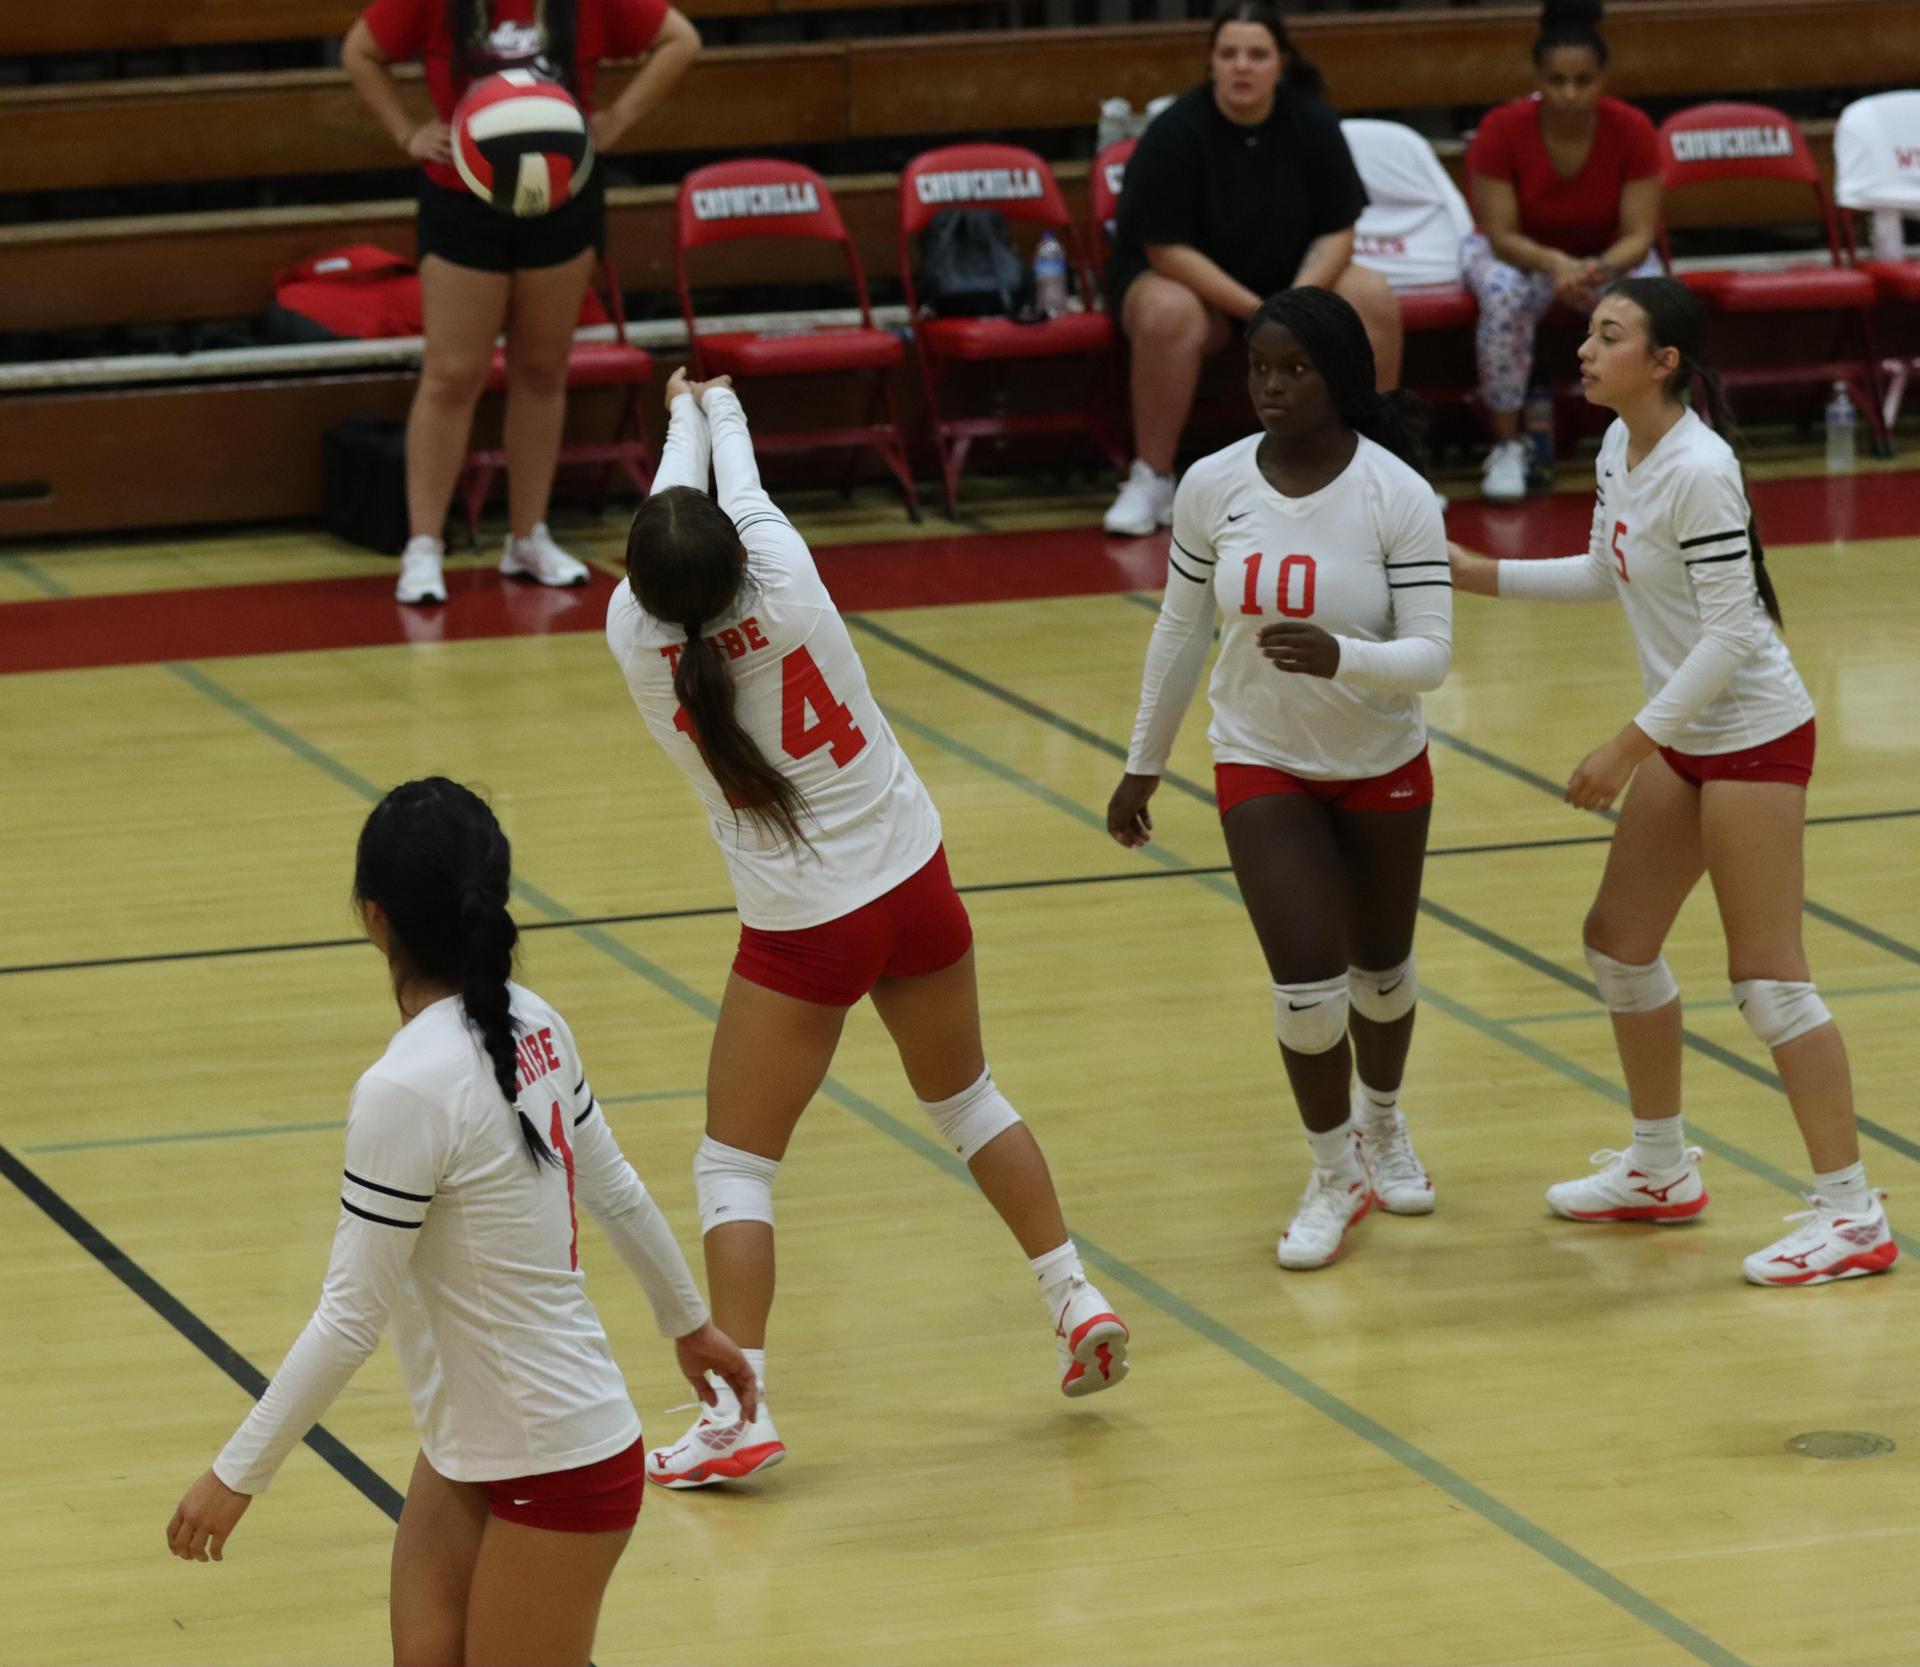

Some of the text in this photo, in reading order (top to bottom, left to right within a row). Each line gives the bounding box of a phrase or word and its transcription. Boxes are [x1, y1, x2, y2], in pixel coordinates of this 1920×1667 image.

[1611, 520, 1630, 583] 5
[1240, 552, 1316, 619] 10
[660, 616, 770, 678] TIBE
[513, 1027, 561, 1094] RIBE
